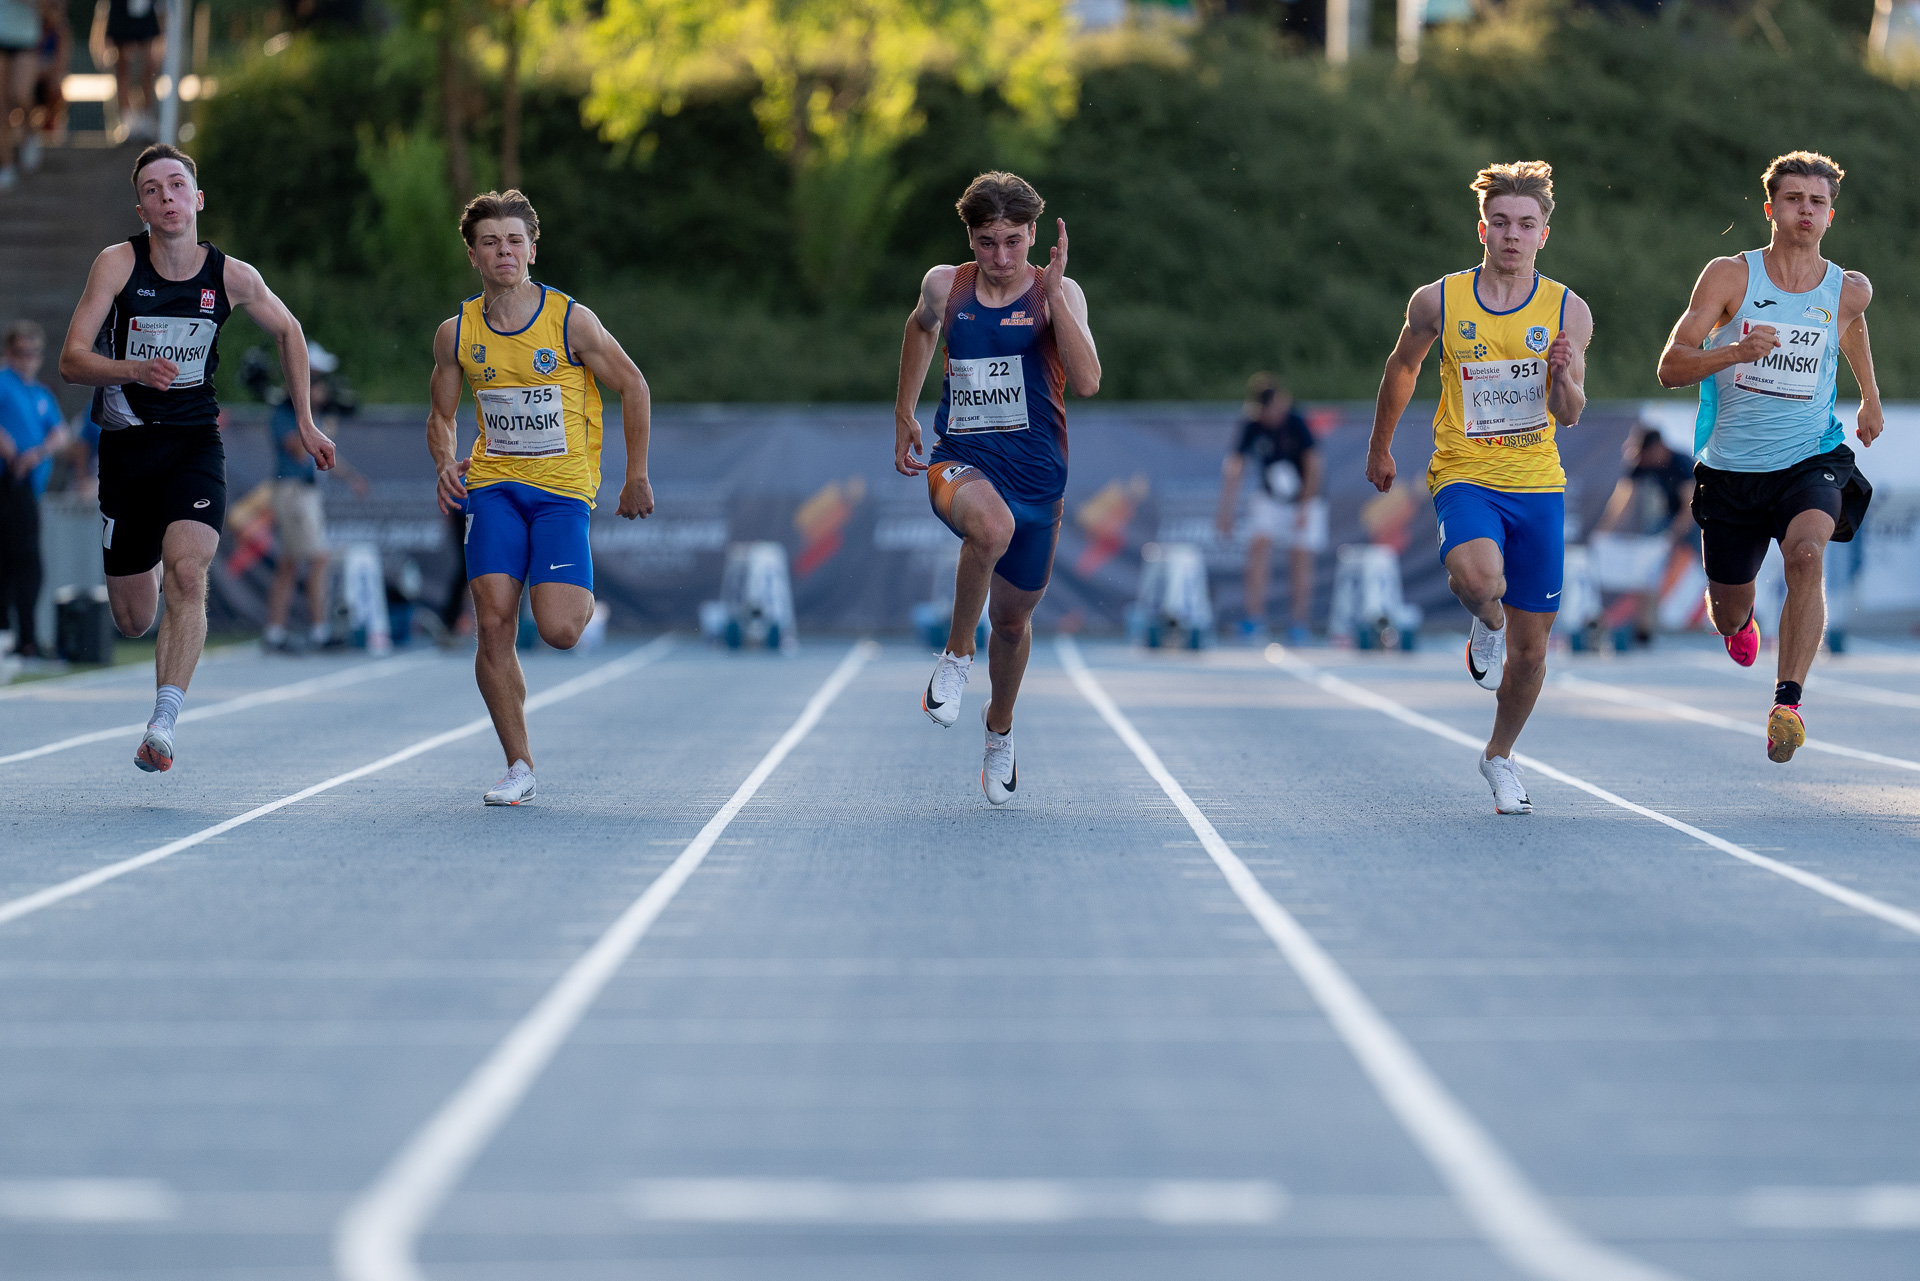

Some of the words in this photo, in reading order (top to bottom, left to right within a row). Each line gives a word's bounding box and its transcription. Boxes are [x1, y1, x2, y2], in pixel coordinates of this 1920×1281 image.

[188, 322, 200, 337] 7
[1789, 329, 1821, 347] 247
[130, 341, 207, 363] LATKOWSKI
[988, 361, 1010, 377] 22
[1510, 361, 1539, 379] 951
[521, 387, 553, 405] 755
[952, 386, 1022, 407] FOREMNY
[1472, 384, 1544, 408] KRAKOWSKI
[484, 411, 560, 432] WOJTASIK
